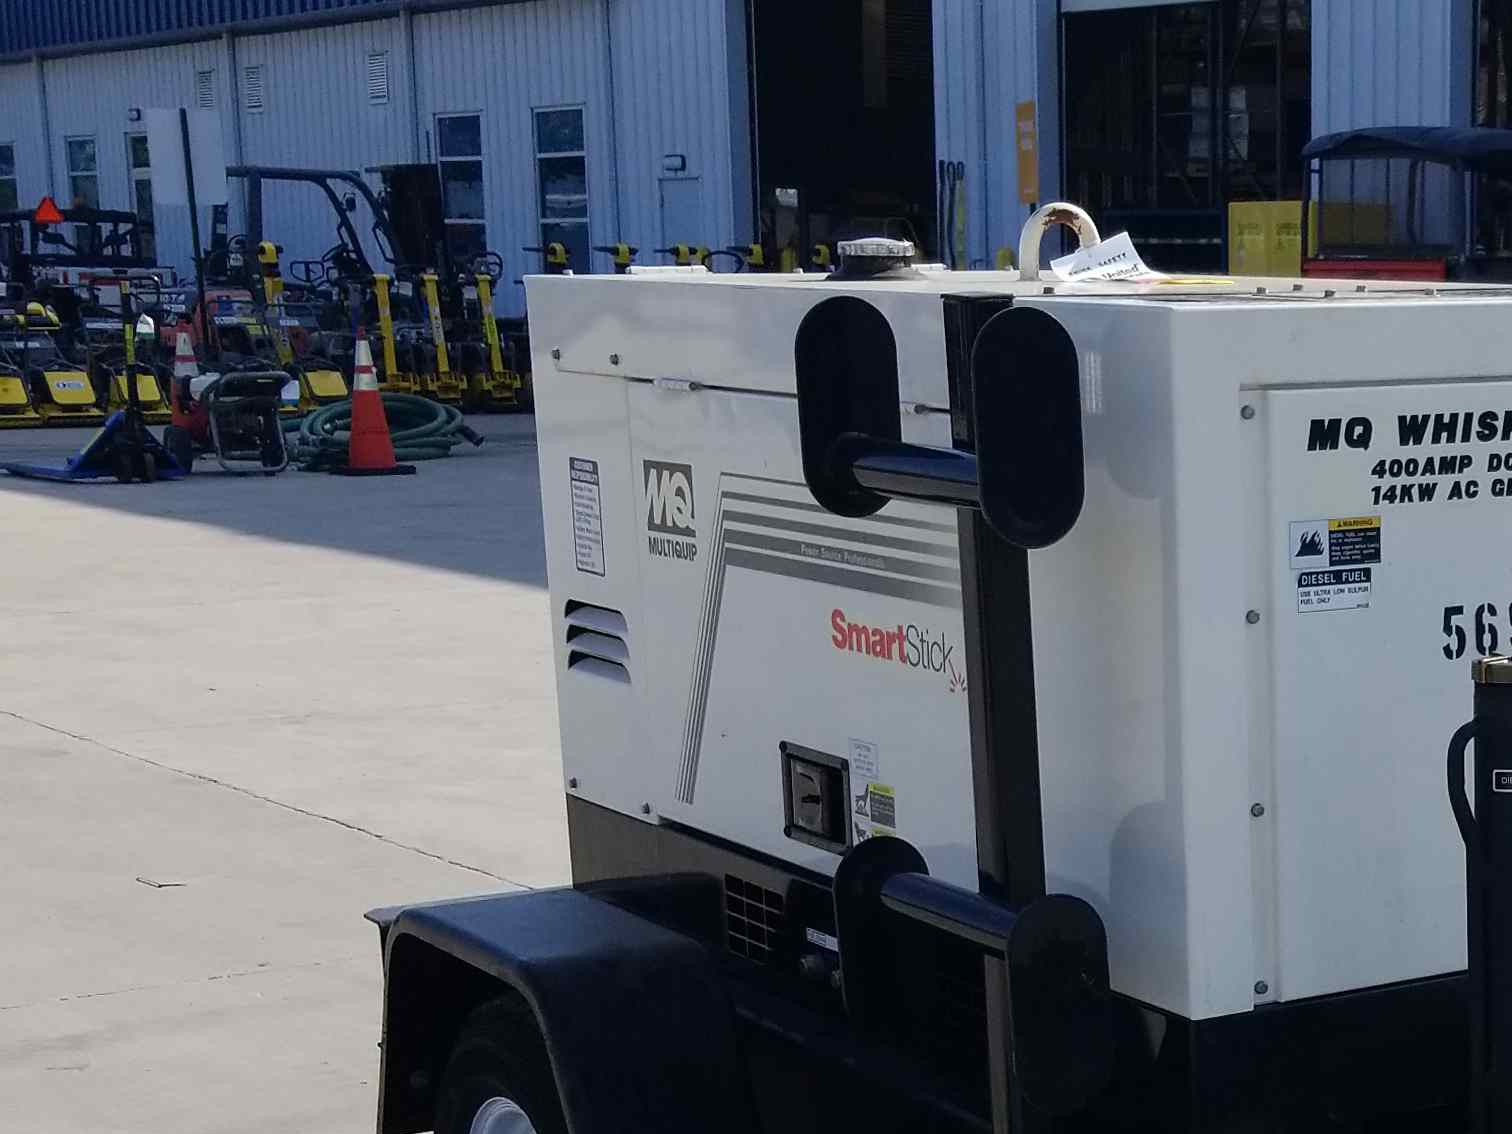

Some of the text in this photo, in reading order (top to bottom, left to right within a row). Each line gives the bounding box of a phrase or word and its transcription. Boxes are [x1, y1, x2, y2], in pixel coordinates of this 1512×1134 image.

[1306, 416, 1374, 451] MQ
[1371, 454, 1473, 479] 400AMP
[642, 466, 696, 532] MQ
[1370, 480, 1438, 506] 14KW
[1447, 478, 1479, 501] AC
[647, 535, 698, 562] MULTIQUIP
[1301, 570, 1367, 586] DIESEL FUEL
[1300, 598, 1314, 606] FUEL
[831, 607, 956, 678] SmartStick
